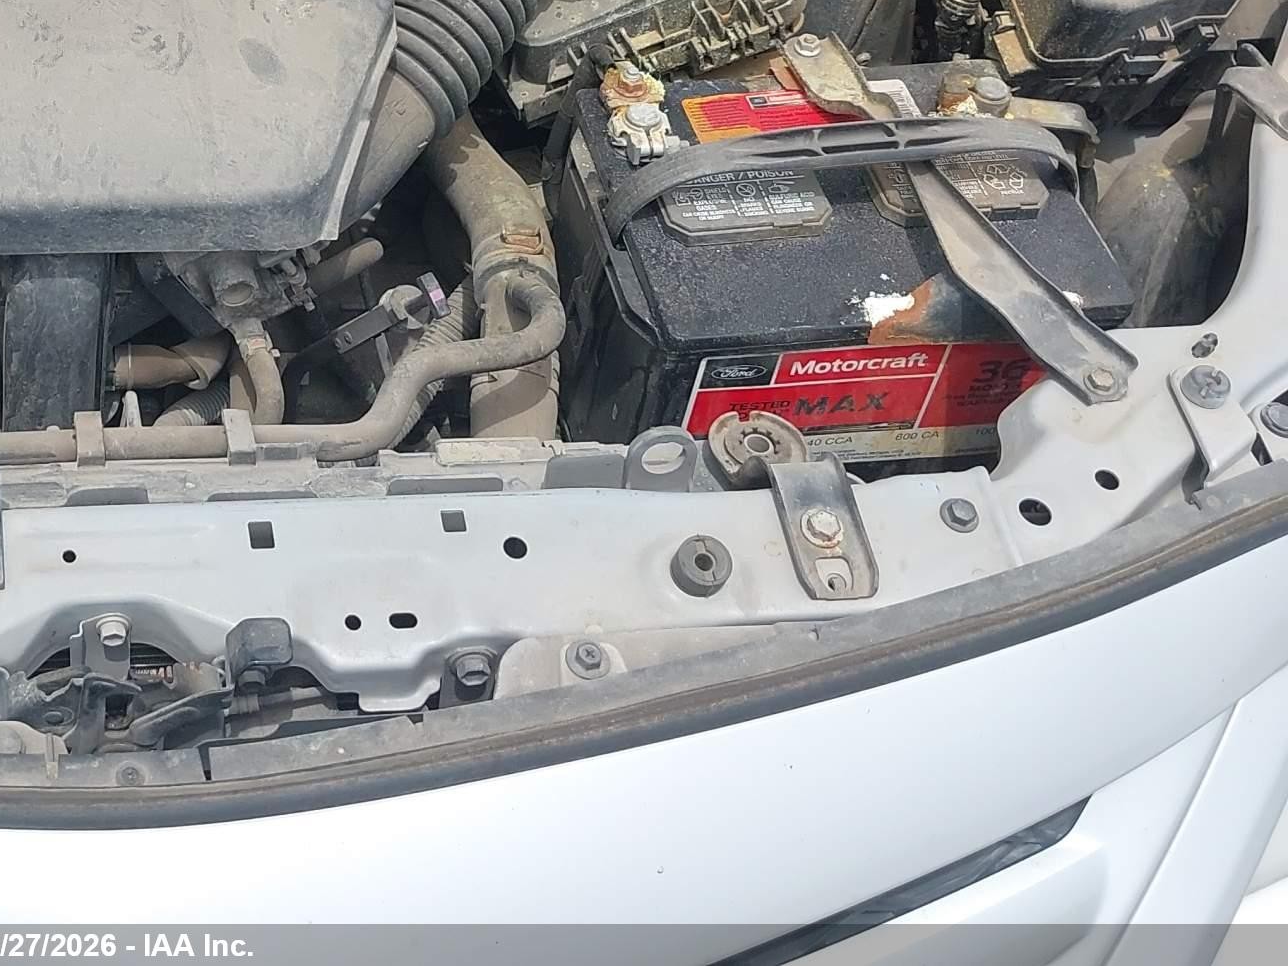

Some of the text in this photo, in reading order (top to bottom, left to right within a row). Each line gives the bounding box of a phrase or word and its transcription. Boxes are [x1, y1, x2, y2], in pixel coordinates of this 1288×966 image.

[687, 172, 736, 184] ANGER
[789, 351, 930, 377] Motorcraft
[794, 390, 889, 417] MAX
[824, 435, 853, 446] CCA
[920, 430, 940, 440] CA
